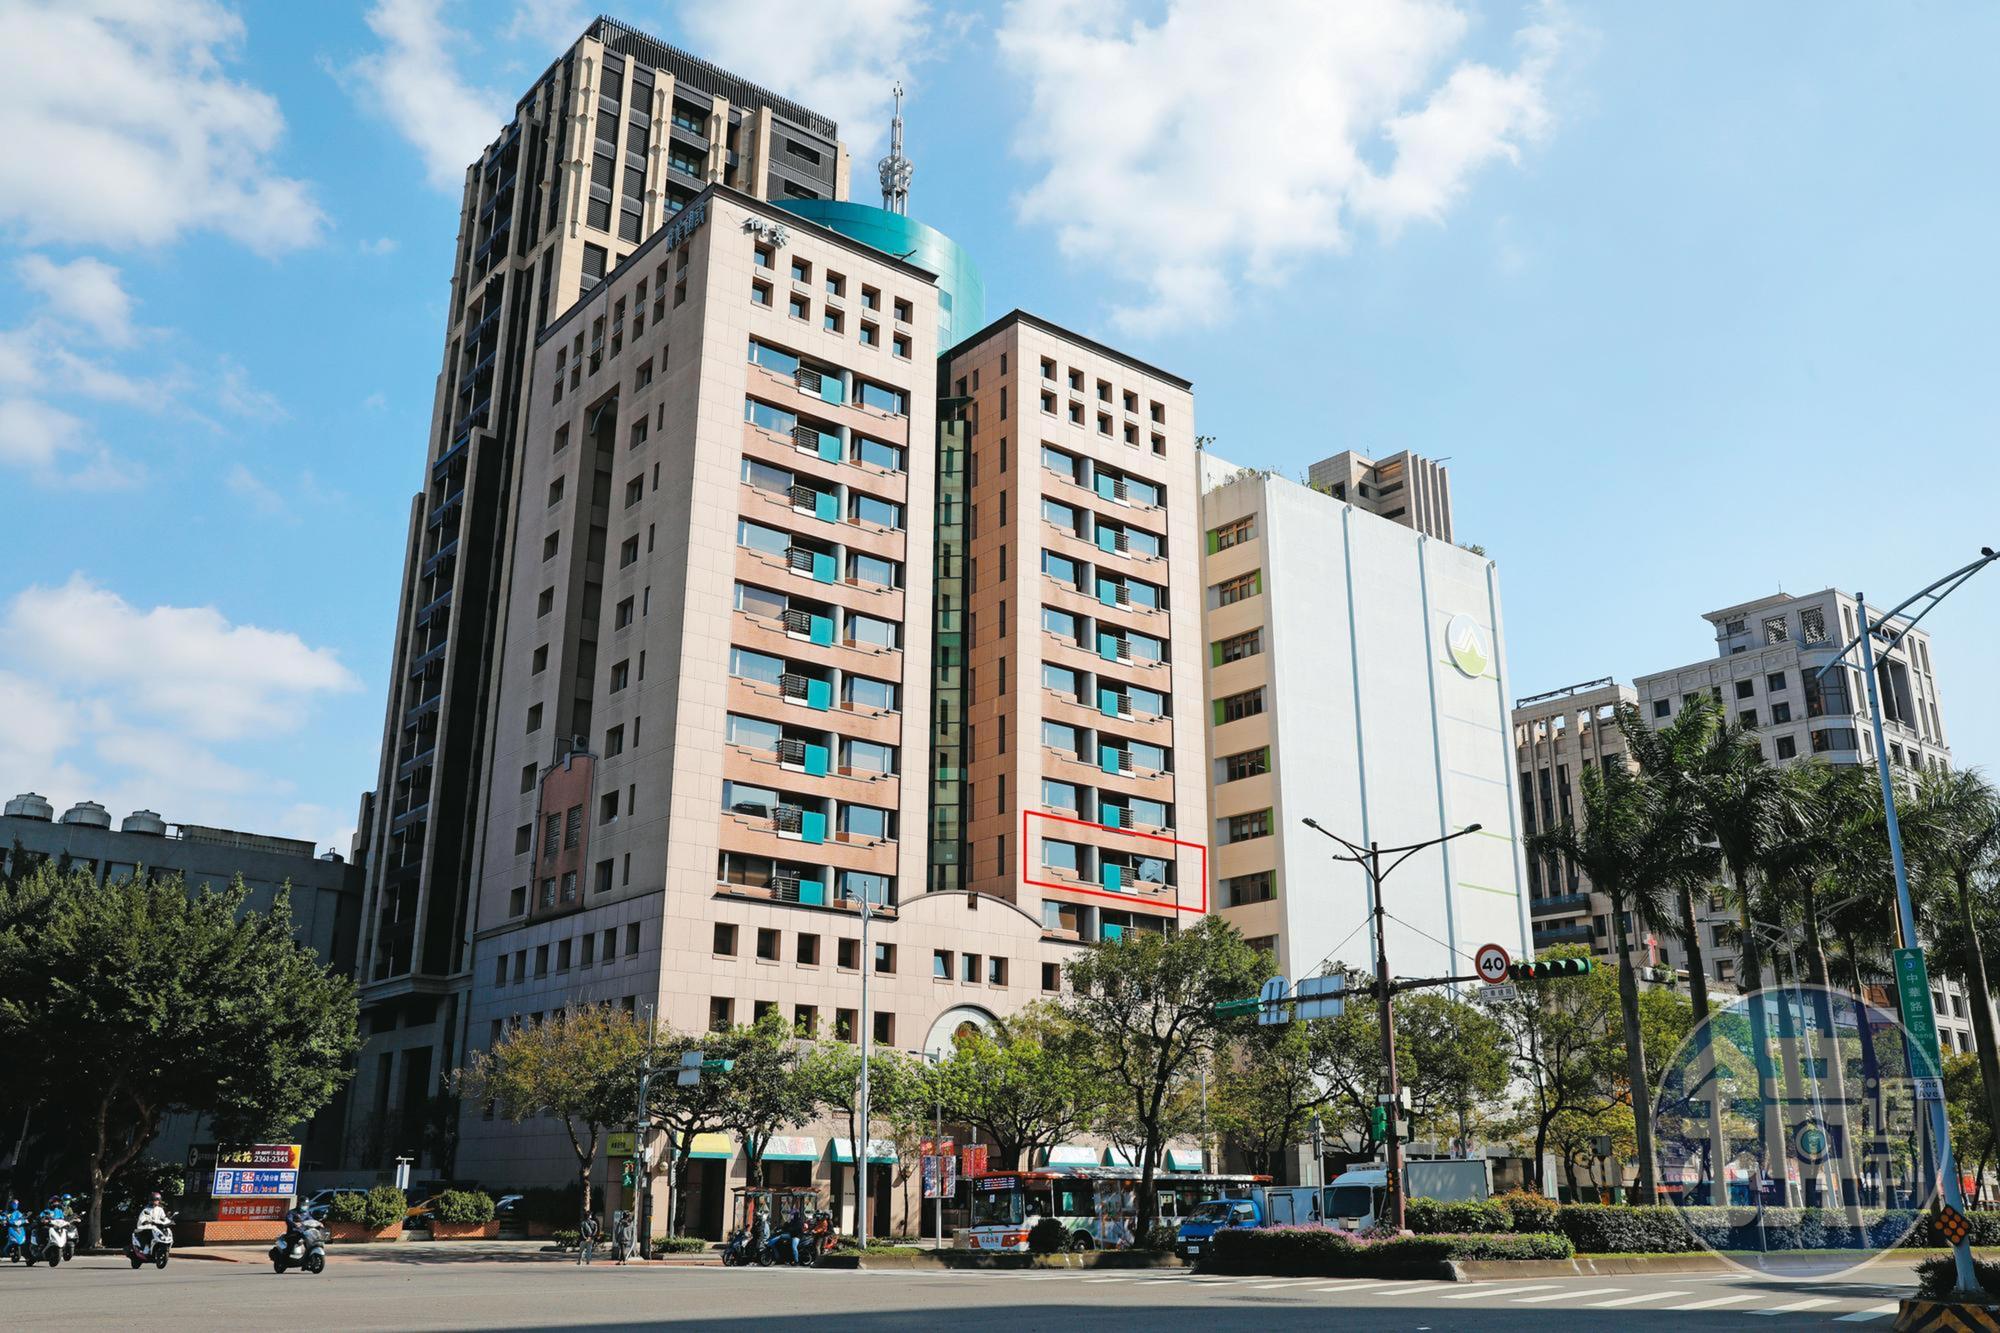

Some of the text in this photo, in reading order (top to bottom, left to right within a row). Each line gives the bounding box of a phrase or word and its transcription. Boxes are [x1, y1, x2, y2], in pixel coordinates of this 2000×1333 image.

[1482, 957, 1504, 972] 40
[1906, 973, 1927, 1032] 中華路一段
[1919, 1080, 1938, 1088] 2nd
[254, 1155, 289, 1163] 2361-2345
